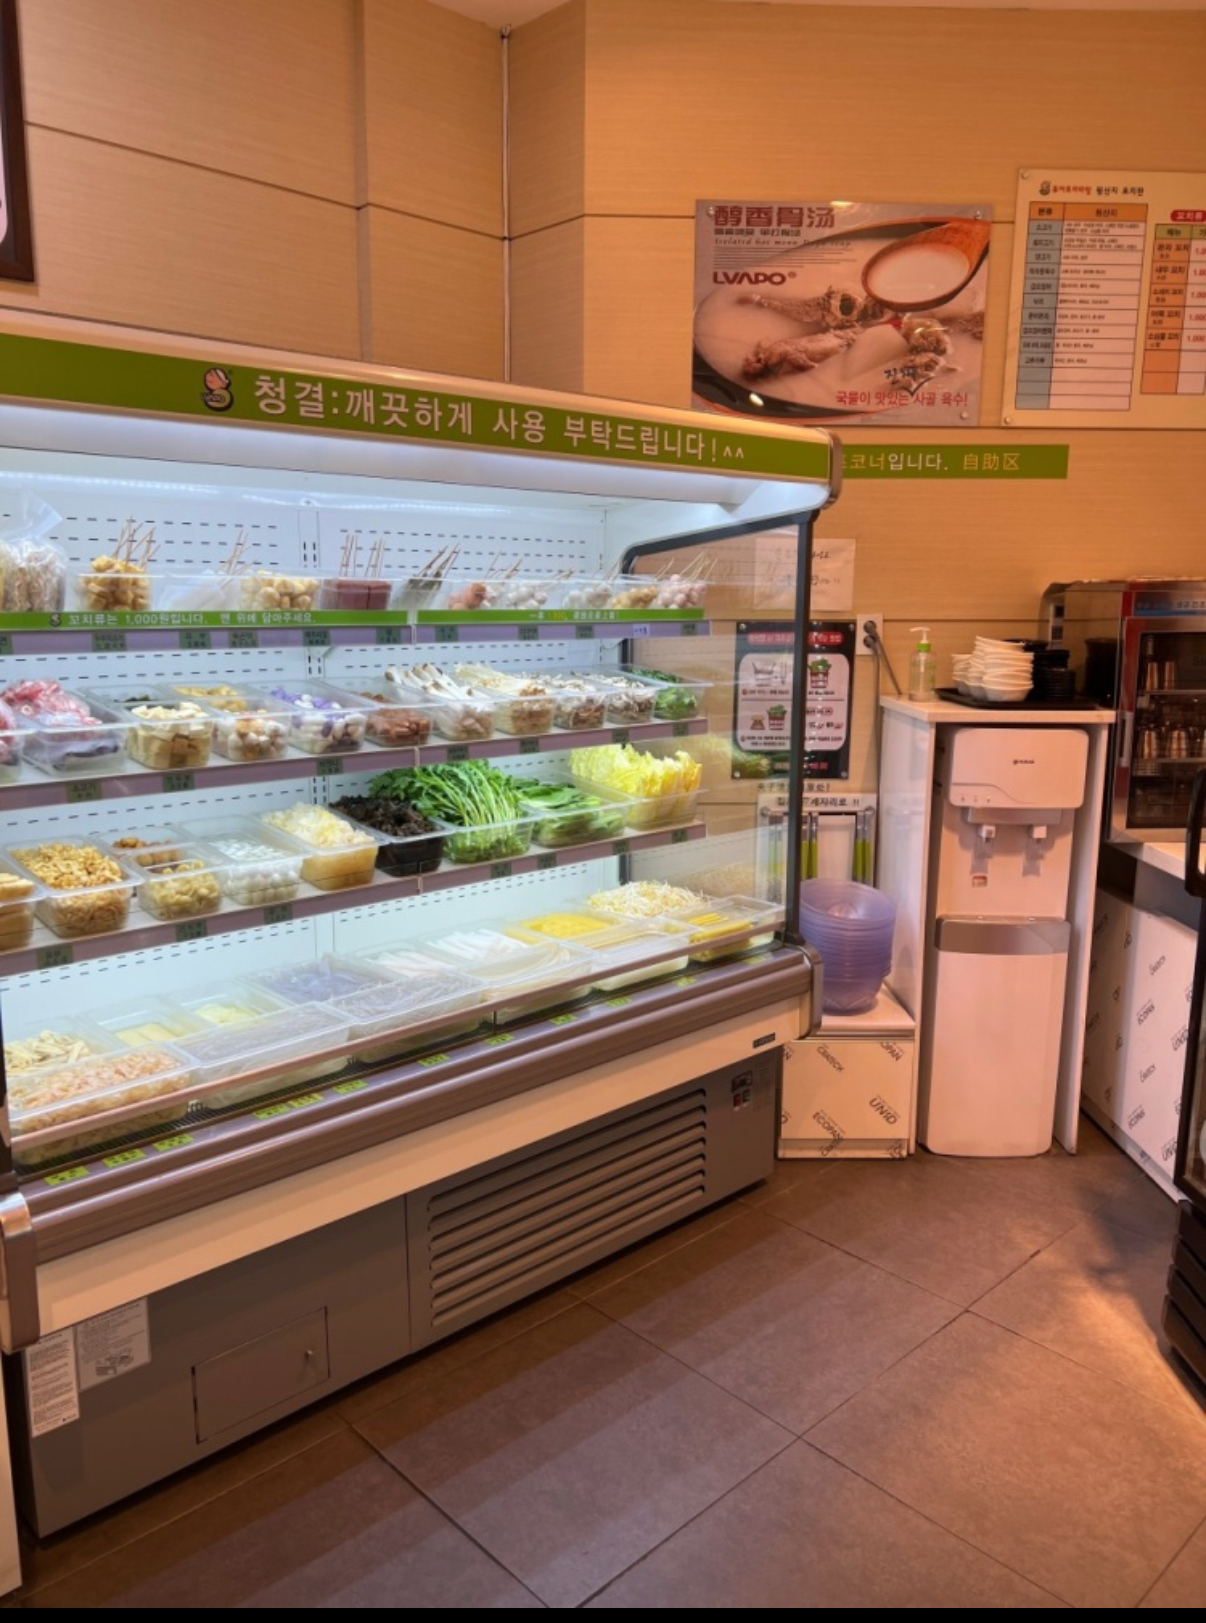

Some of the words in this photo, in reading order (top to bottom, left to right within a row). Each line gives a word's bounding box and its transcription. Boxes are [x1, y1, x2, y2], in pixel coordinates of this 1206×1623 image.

[836, 390, 871, 406] 국물이
[875, 391, 909, 406] 맛있는
[491, 407, 547, 443] 사용
[962, 453, 1021, 471] 自助区
[68, 614, 118, 625] 꼬치류는
[869, 1096, 898, 1125] UNID
